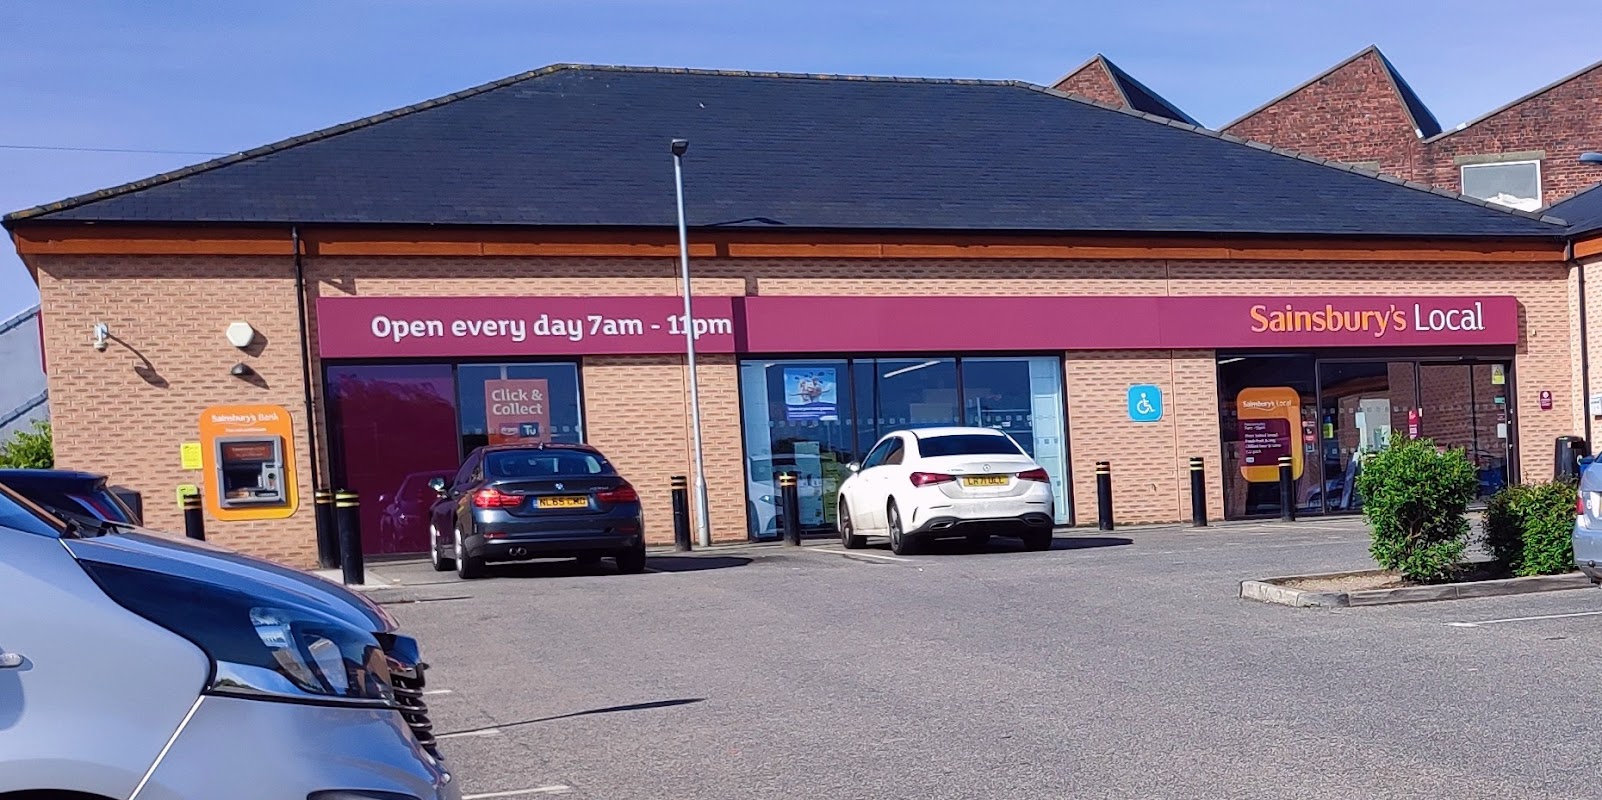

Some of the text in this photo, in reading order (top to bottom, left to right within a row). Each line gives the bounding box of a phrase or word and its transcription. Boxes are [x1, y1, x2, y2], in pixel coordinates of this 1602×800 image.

[1250, 302, 1485, 338] Sainsbury's Local
[371, 315, 444, 342] Open
[451, 318, 526, 342] every
[533, 314, 583, 341] day
[587, 315, 643, 336] 7am
[667, 314, 732, 340] 11pm
[491, 388, 543, 401] Click &
[492, 402, 543, 416] Collect
[211, 412, 279, 423] Sainsbury's Bank
